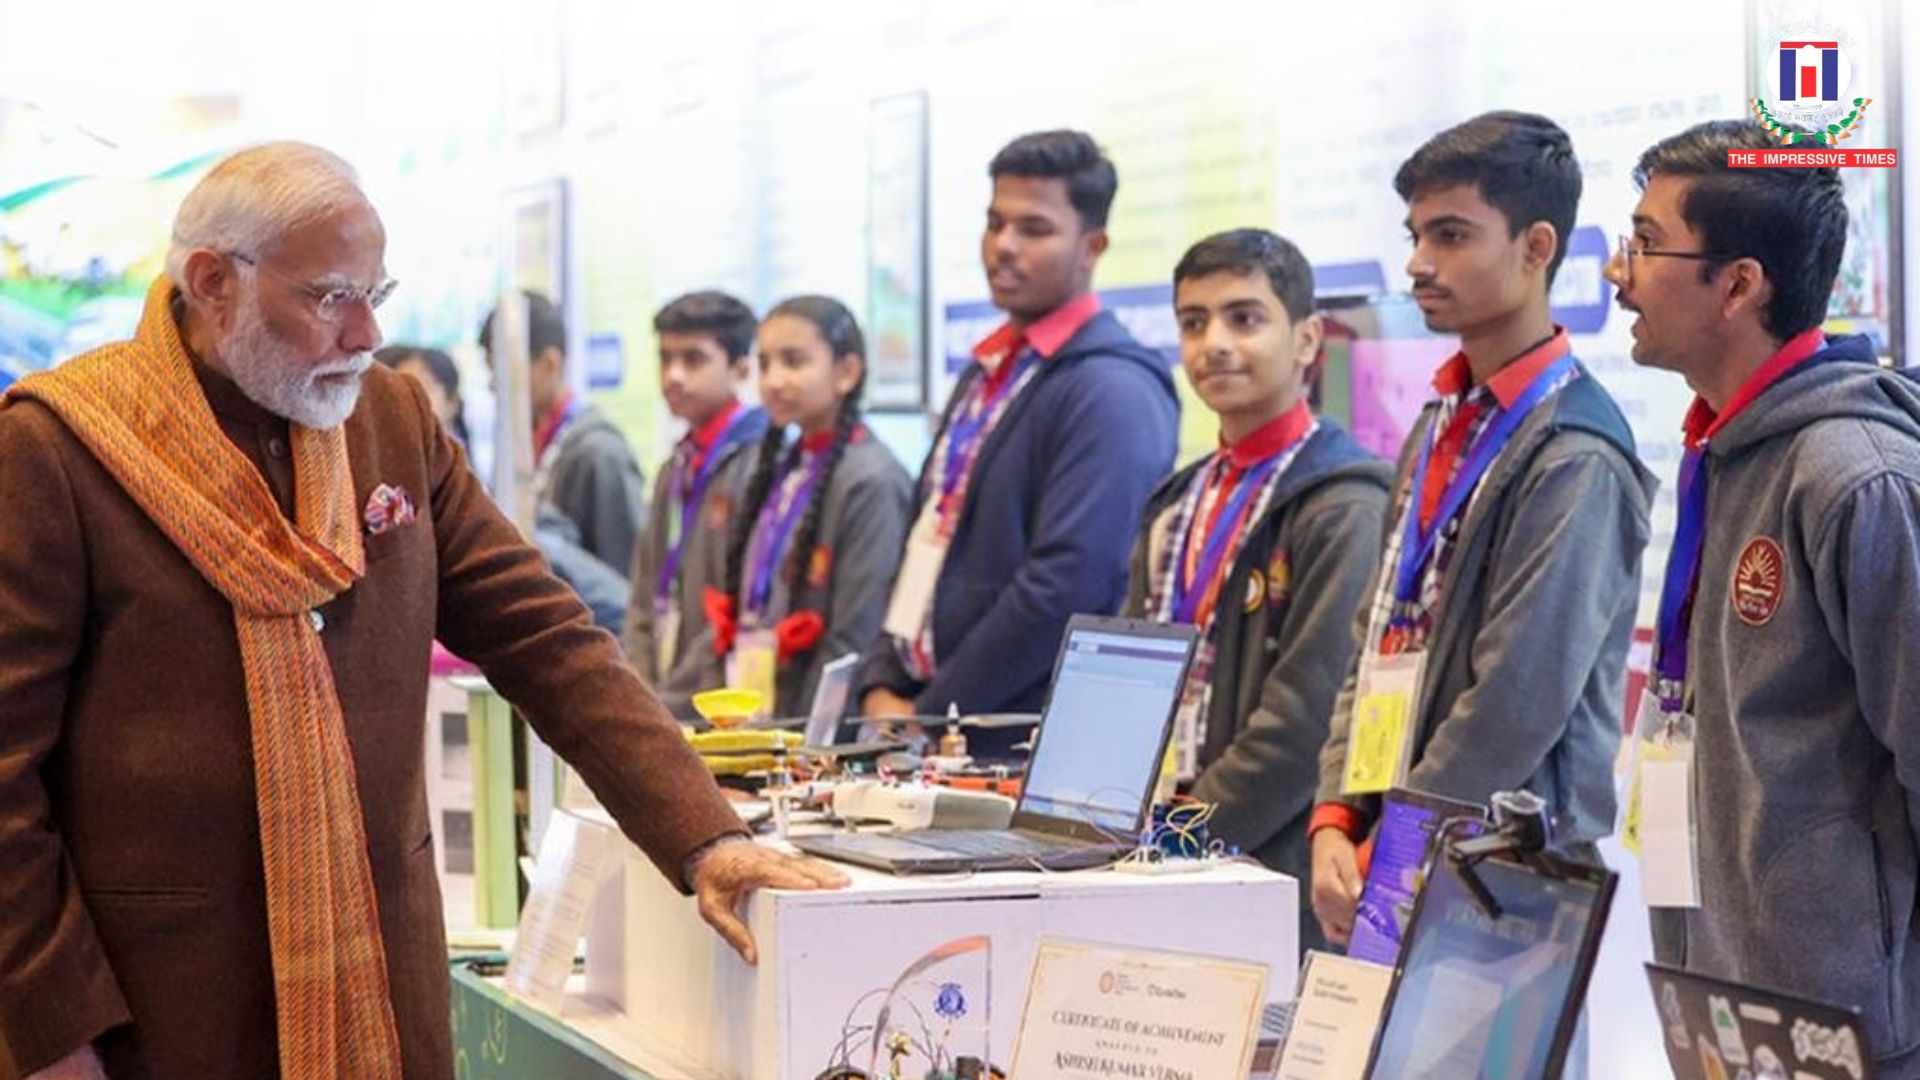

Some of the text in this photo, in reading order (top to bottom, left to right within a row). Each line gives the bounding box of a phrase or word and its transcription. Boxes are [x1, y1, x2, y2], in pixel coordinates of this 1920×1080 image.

[1052, 1010, 1227, 1046] CERTIFICATE OF ACHIEVEMENT
